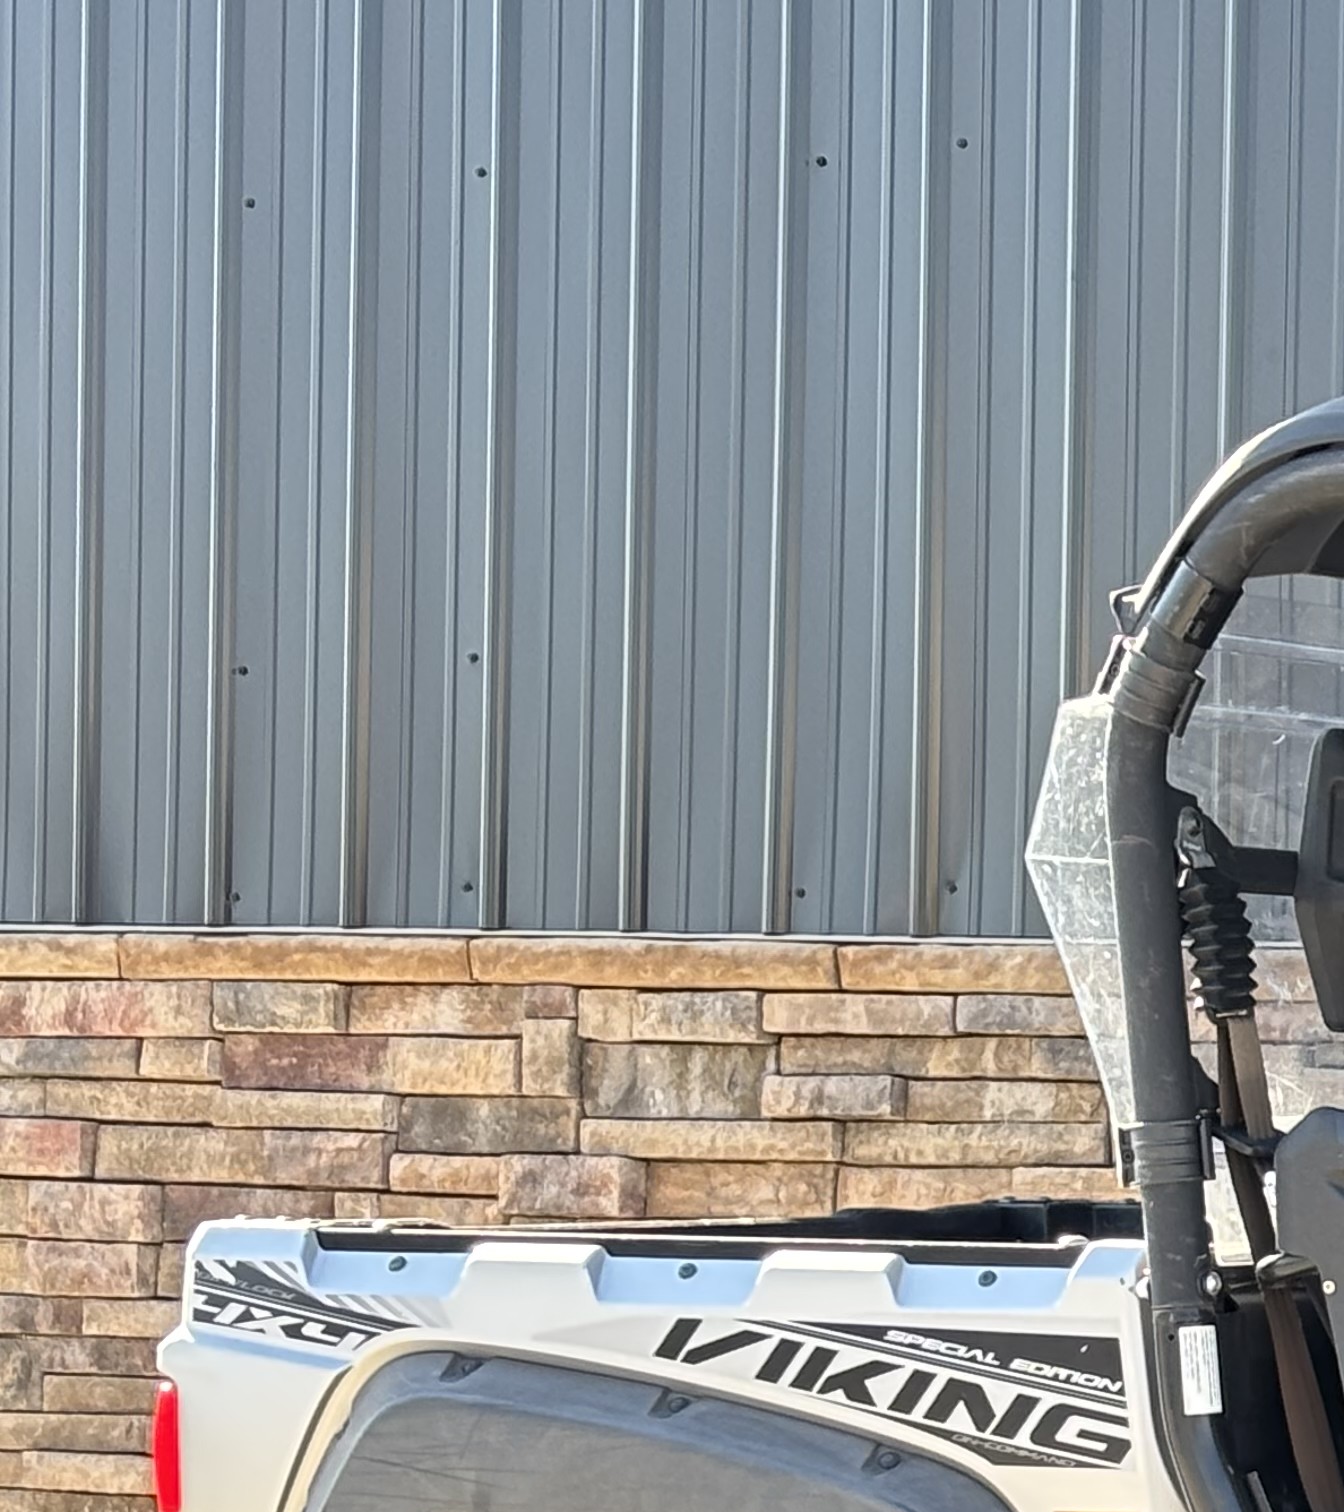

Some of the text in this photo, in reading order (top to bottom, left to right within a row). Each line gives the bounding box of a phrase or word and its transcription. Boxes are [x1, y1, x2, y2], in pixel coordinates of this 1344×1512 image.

[654, 1317, 1132, 1465] VIKING
[883, 1329, 1123, 1393] SPECIAL EDITION
[951, 1433, 1077, 1467] ON-COMMAND
